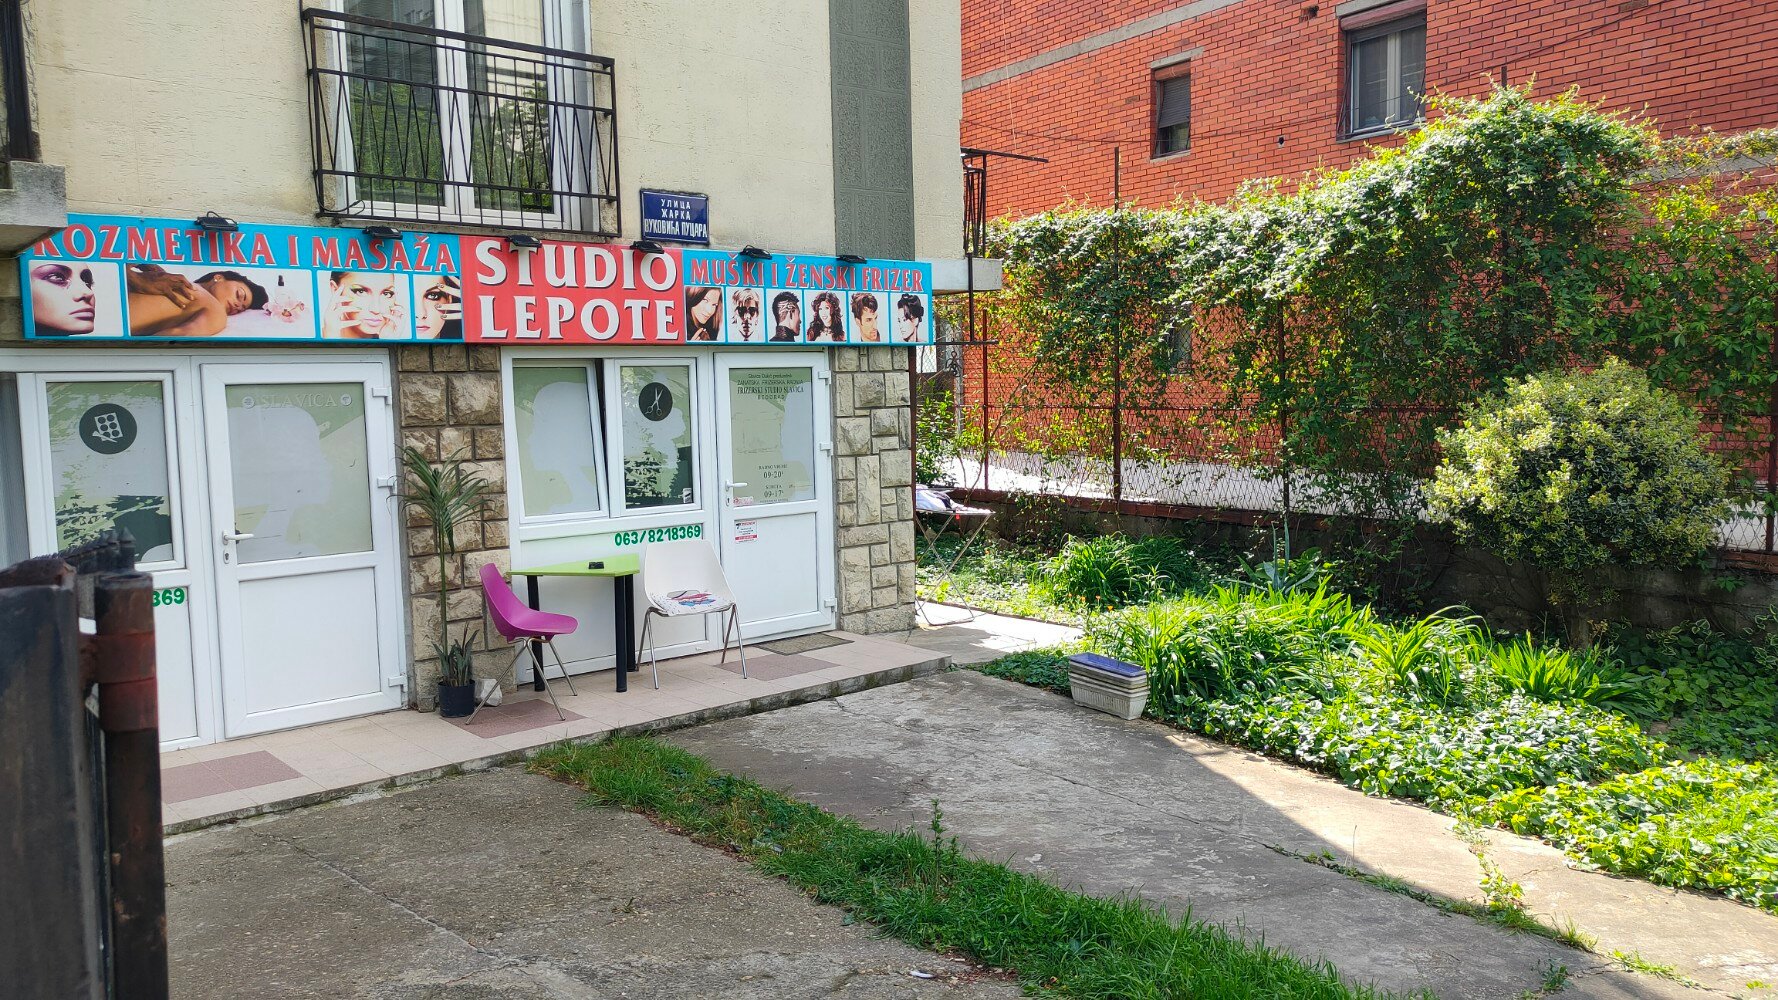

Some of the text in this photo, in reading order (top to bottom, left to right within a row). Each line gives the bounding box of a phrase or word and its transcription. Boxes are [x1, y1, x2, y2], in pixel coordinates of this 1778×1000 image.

[661, 198, 691, 209] УЛИЦА
[661, 208, 691, 220] ЖАРКА
[644, 218, 708, 238] ВУКОВИЋА ПУЦАРА
[288, 235, 300, 266] I
[311, 234, 457, 273] MASAŽA
[475, 240, 677, 291] STUDIO
[691, 252, 924, 292] MUŠKI I ŽENSKI FRIZER
[478, 295, 680, 340] LEPOTE
[261, 392, 338, 409] SLAVICA
[614, 525, 701, 547] 063/8218369
